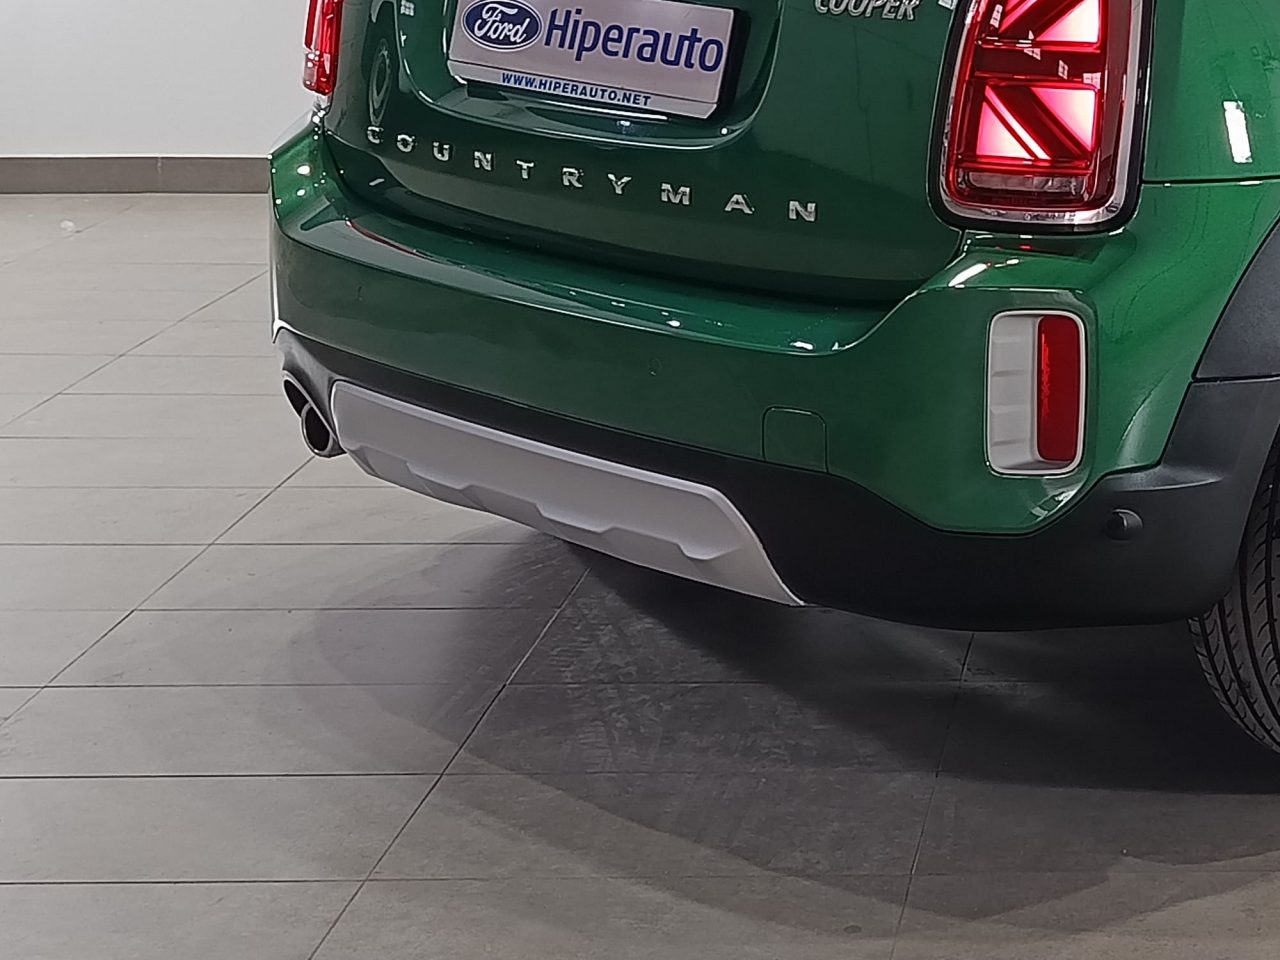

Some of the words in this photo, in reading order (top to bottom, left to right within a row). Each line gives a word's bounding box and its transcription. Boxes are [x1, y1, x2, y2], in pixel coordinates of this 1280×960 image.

[474, 3, 530, 44] Ford
[543, 8, 724, 72] Hiperauto
[501, 72, 652, 106] WWW.HIPERAUTO.NET
[367, 126, 817, 222] COUNTRYMAN
